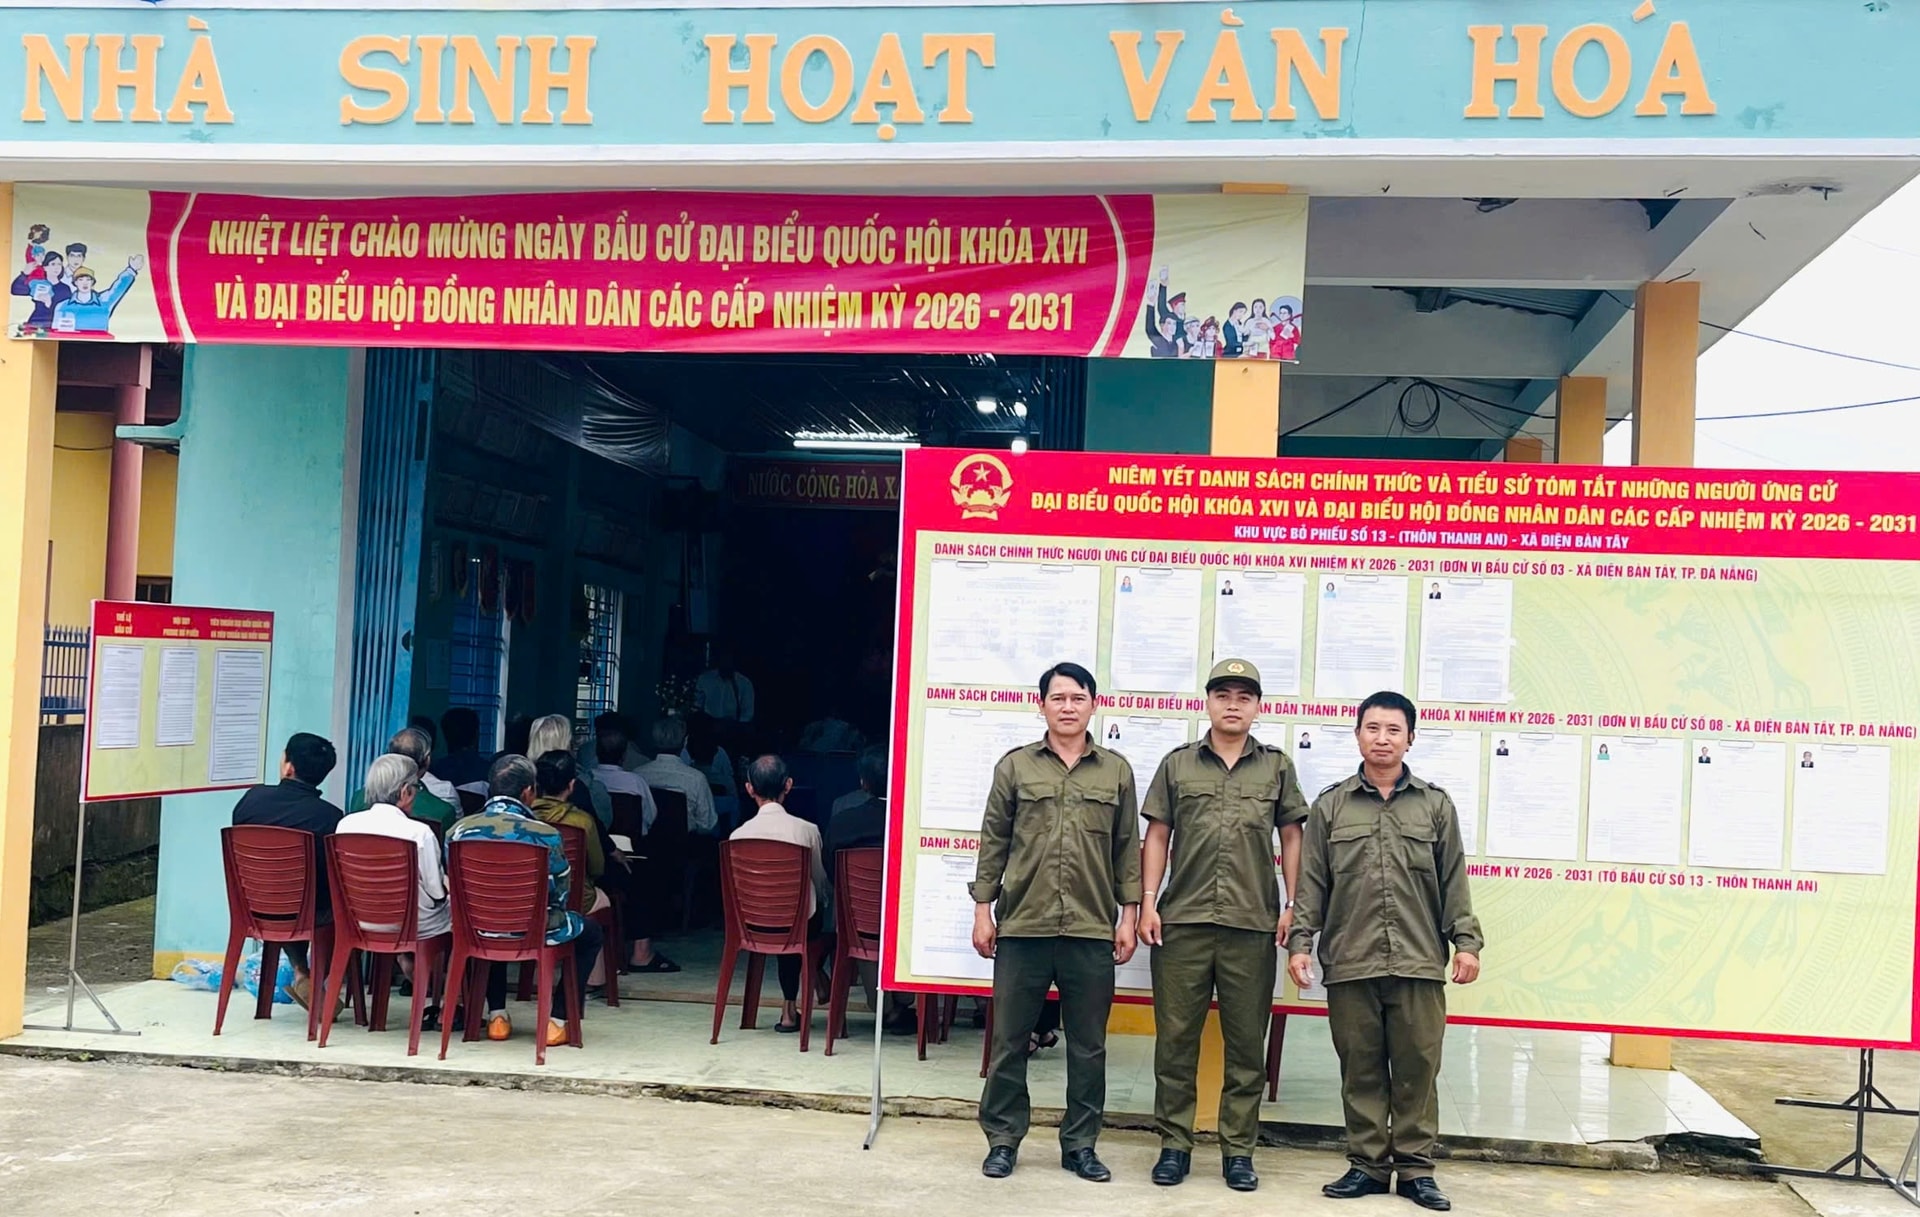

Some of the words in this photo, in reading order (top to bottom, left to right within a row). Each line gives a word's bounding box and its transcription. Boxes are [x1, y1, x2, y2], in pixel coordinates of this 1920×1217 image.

[21, 15, 234, 123] NHÀ
[340, 35, 597, 124] SINH
[702, 33, 995, 140] HOẠT
[1464, 0, 1717, 118] HOÁ
[209, 214, 285, 263] NHIỆT
[290, 215, 344, 264] LIỆT
[350, 216, 419, 257] CHÀO
[428, 217, 505, 259] MỪNG
[515, 216, 585, 259] NGÀY
[594, 211, 646, 261] BẦU
[656, 212, 694, 261] CỬ
[699, 225, 744, 270] ĐẠI
[753, 211, 814, 263] BIỂU
[824, 214, 895, 267] QUỐC
[905, 219, 950, 272] HỘI
[960, 220, 1033, 264] KHÓA
[1042, 228, 1087, 263] XVI
[215, 275, 247, 319] VÀ
[255, 283, 298, 328] ĐẠI
[306, 271, 364, 321] BIỂU
[372, 278, 415, 330] HỘI
[423, 274, 495, 324] ĐỒNG
[503, 280, 577, 325] NHÂN
[585, 281, 640, 326] DÂN
[649, 282, 702, 327] CÁC
[711, 278, 765, 328] CẤP
[774, 284, 862, 335] NHIỆM
[870, 284, 906, 328] KỲ
[913, 293, 981, 330] 2026
[990, 309, 999, 317] -
[1008, 292, 1072, 330] 2031
[845, 469, 880, 500] HÒA
[1109, 465, 1156, 485] NIÊM
[1162, 465, 1194, 486] YẾT
[1200, 470, 1249, 487] DANH
[1255, 469, 1305, 489] SÁCH
[1311, 471, 1368, 491] CHÍNH
[1374, 472, 1421, 492] THỨC
[1428, 473, 1451, 493] VÀ
[1458, 471, 1498, 494] TIỂU
[1504, 473, 1532, 495] SỬ
[1535, 476, 1576, 496] TÓM
[1582, 474, 1616, 497] TẮT
[1622, 478, 1689, 499] NHỮNG
[1695, 480, 1755, 500] NGƯỜI
[1762, 481, 1802, 501] ỨNG
[1809, 480, 1838, 502] CỬ
[1032, 492, 1061, 512] ĐẠI
[1067, 489, 1108, 511] BIỂU
[1114, 491, 1162, 513] QUỐC
[1168, 494, 1198, 517] HỘI
[1205, 496, 1253, 515] KHÓA
[1260, 500, 1289, 516] XVI
[1295, 498, 1318, 517] VÀ
[1324, 502, 1355, 522] ĐẠI
[1361, 497, 1404, 520] BIỂU
[1410, 501, 1441, 524] HỘI
[1447, 500, 1499, 522] ĐỒNG
[1505, 504, 1559, 524] NHÂN
[1565, 505, 1604, 525] DÂN
[1611, 506, 1649, 526] CÁC
[1656, 505, 1694, 527] CẤP
[1700, 509, 1764, 532] NHIỆM
[1771, 510, 1796, 530] KỲ
[1802, 513, 1850, 531] 2026
[1870, 515, 1916, 532] 2031
[1234, 526, 1259, 538] KHU
[1262, 525, 1287, 541] VỰC
[1310, 525, 1347, 541] PHIẾU
[1351, 525, 1367, 541] SỐ
[1372, 530, 1386, 541] 13
[1398, 528, 1437, 544] (THÔN
[1440, 532, 1482, 545] THANH
[1485, 534, 1508, 546] AN)
[1521, 532, 1538, 546] XÃ
[1542, 533, 1571, 549] ĐIỆN
[1575, 533, 1602, 547] BÀN
[1605, 534, 1629, 549] TÂY
[1408, 560, 1434, 572] 2031
[1550, 564, 1564, 576] 03
[927, 688, 956, 700] DANH
[1454, 710, 1465, 721] XI
[1527, 713, 1555, 725] 2026
[1567, 714, 1593, 726] 2031
[1709, 719, 1723, 731] 08
[920, 837, 950, 848] DANH
[1524, 867, 1552, 879] 2026
[1565, 869, 1592, 881] 2031
[1690, 875, 1703, 887] 13
